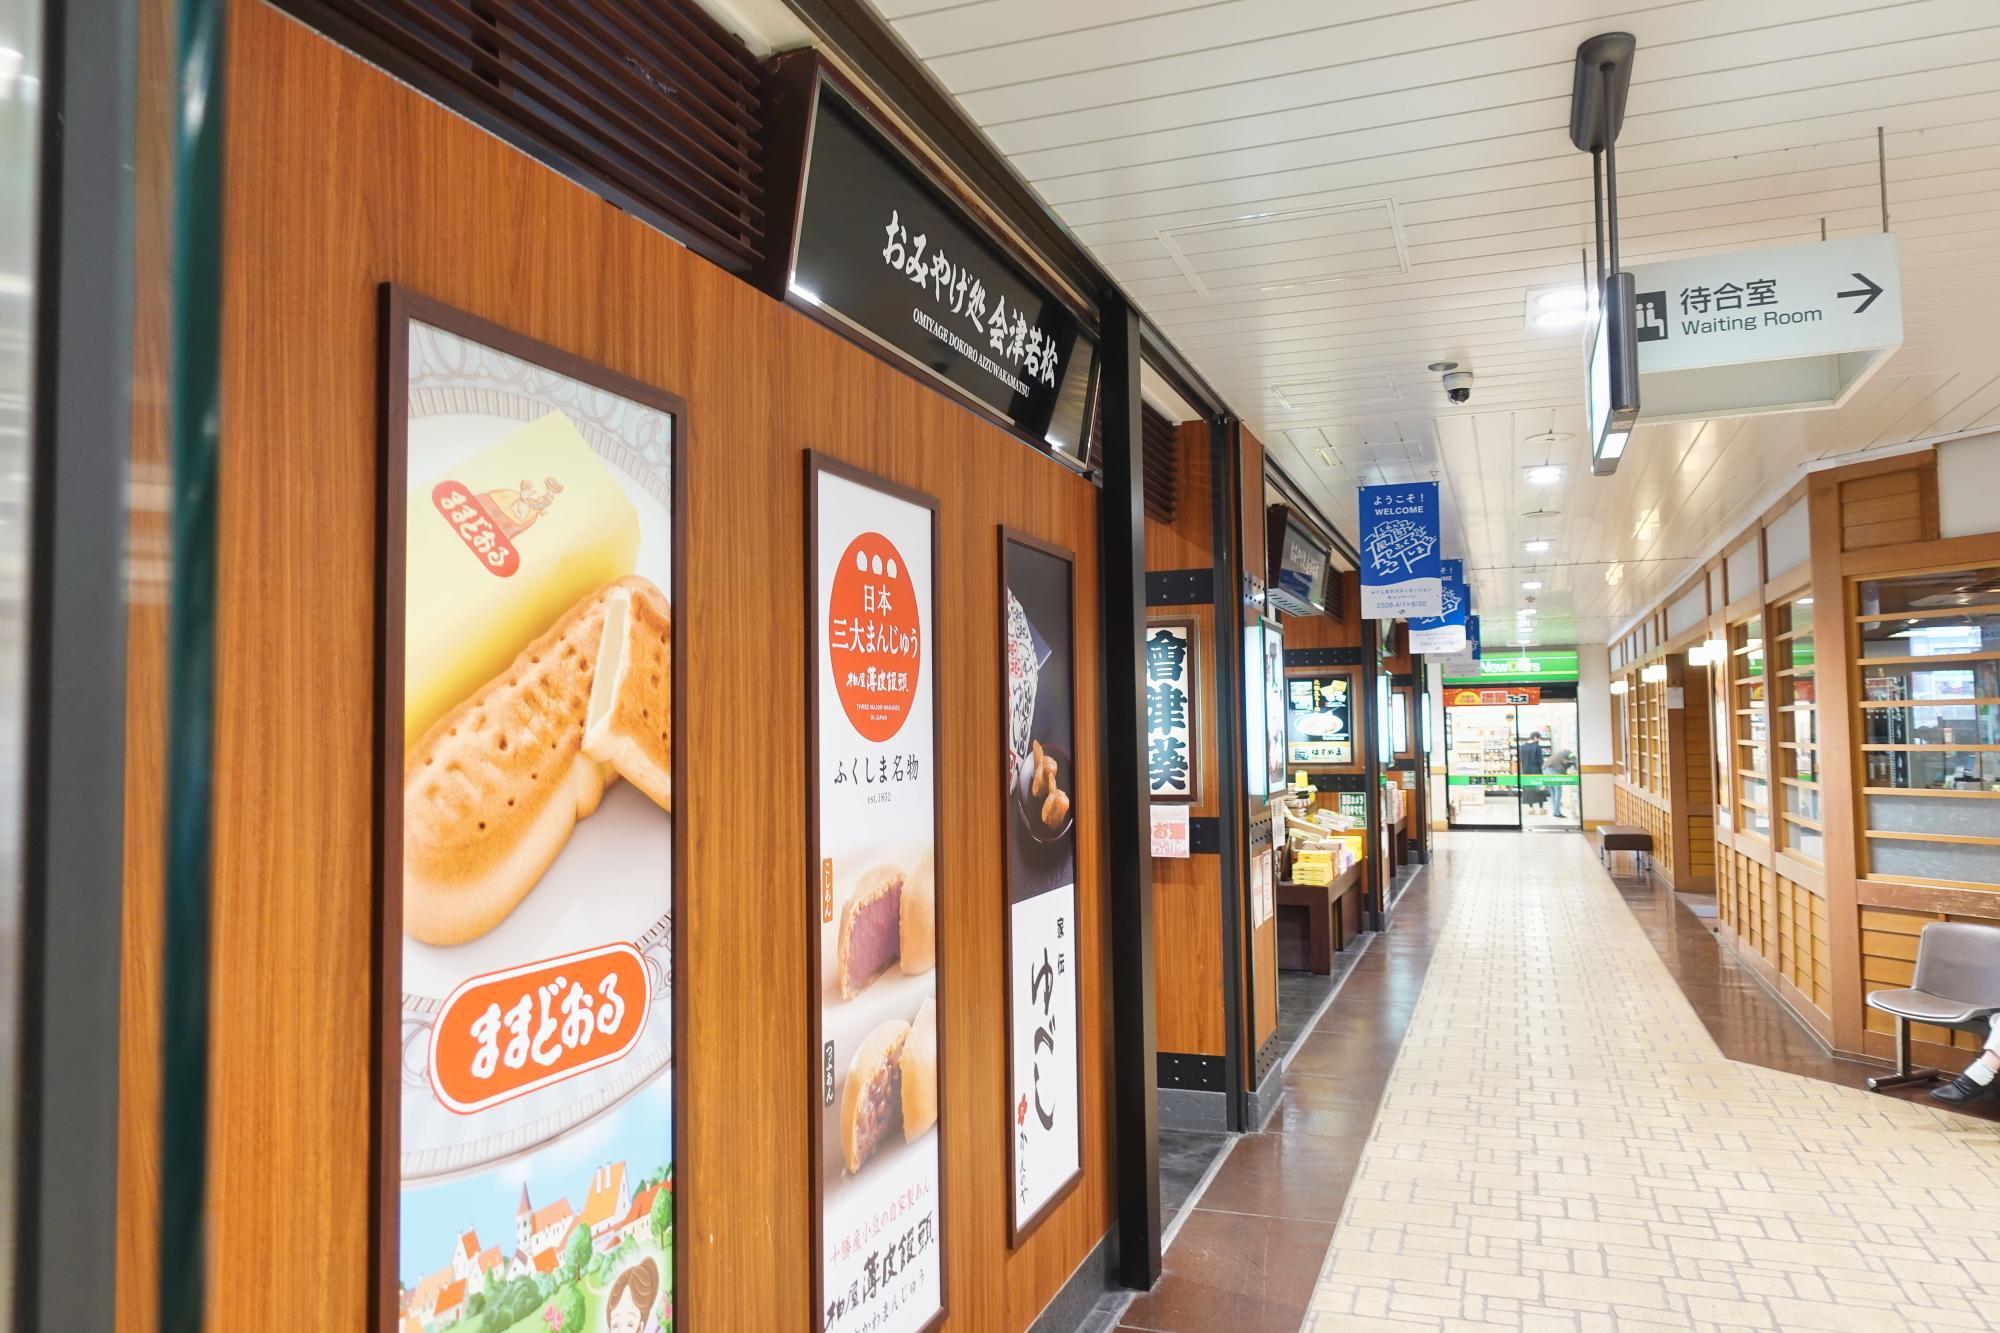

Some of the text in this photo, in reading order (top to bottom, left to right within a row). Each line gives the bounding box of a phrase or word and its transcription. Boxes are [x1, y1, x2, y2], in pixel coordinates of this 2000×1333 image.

[883, 209, 1058, 388] おみやげ処 会津若松
[1679, 278, 1779, 316] 待合室
[1681, 307, 1823, 336] Waiting Room
[912, 307, 1030, 398] OMIYAGE DOKORO AIZUWAKAMATSU
[440, 490, 508, 567] ままどおる
[1375, 505, 1425, 516] WELCOME
[863, 584, 893, 617] 日本
[831, 617, 918, 659] 三大まんじゅう
[856, 703, 870, 711] THREE
[870, 703, 883, 711] MAJOR
[834, 753, 920, 786] ふくしま名物
[824, 862, 832, 917] こしあん
[1057, 916, 1065, 975] 家伝
[470, 972, 625, 1079] ままどおる
[1031, 946, 1056, 1131] ゆべし
[825, 1044, 834, 1103] つぶあん
